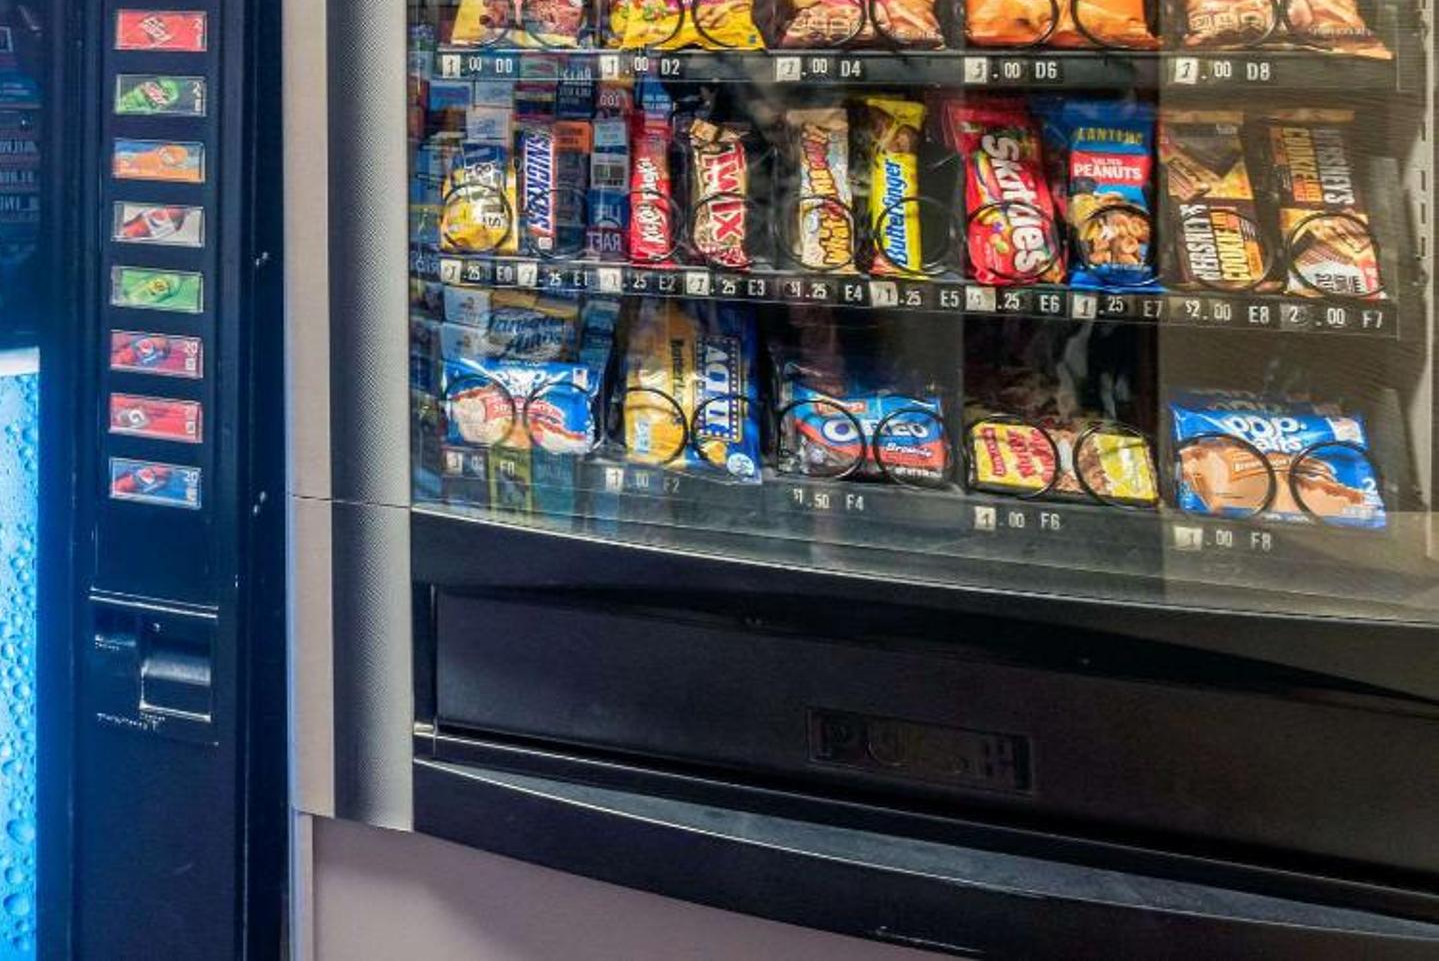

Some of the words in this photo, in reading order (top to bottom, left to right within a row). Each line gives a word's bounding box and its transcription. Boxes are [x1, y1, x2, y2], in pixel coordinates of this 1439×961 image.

[660, 56, 681, 77] D2
[840, 59, 862, 78] D4
[1034, 60, 1059, 80] D6
[1246, 61, 1272, 81] D8
[1072, 162, 1143, 180] PEANUTS
[525, 130, 555, 235] SNICKERS
[703, 142, 747, 240] TWIX
[881, 158, 910, 267] Butterfinger
[1213, 231, 1252, 281] COOKIE
[747, 278, 766, 297] E3
[843, 283, 863, 302] E4
[939, 290, 960, 309] E5
[1039, 294, 1061, 314] E6
[1142, 300, 1162, 318] E7
[1247, 305, 1271, 324] E8
[1362, 310, 1384, 329] F7
[845, 494, 865, 511] F4
[1040, 512, 1061, 531] F6
[1250, 531, 1273, 551] F8
